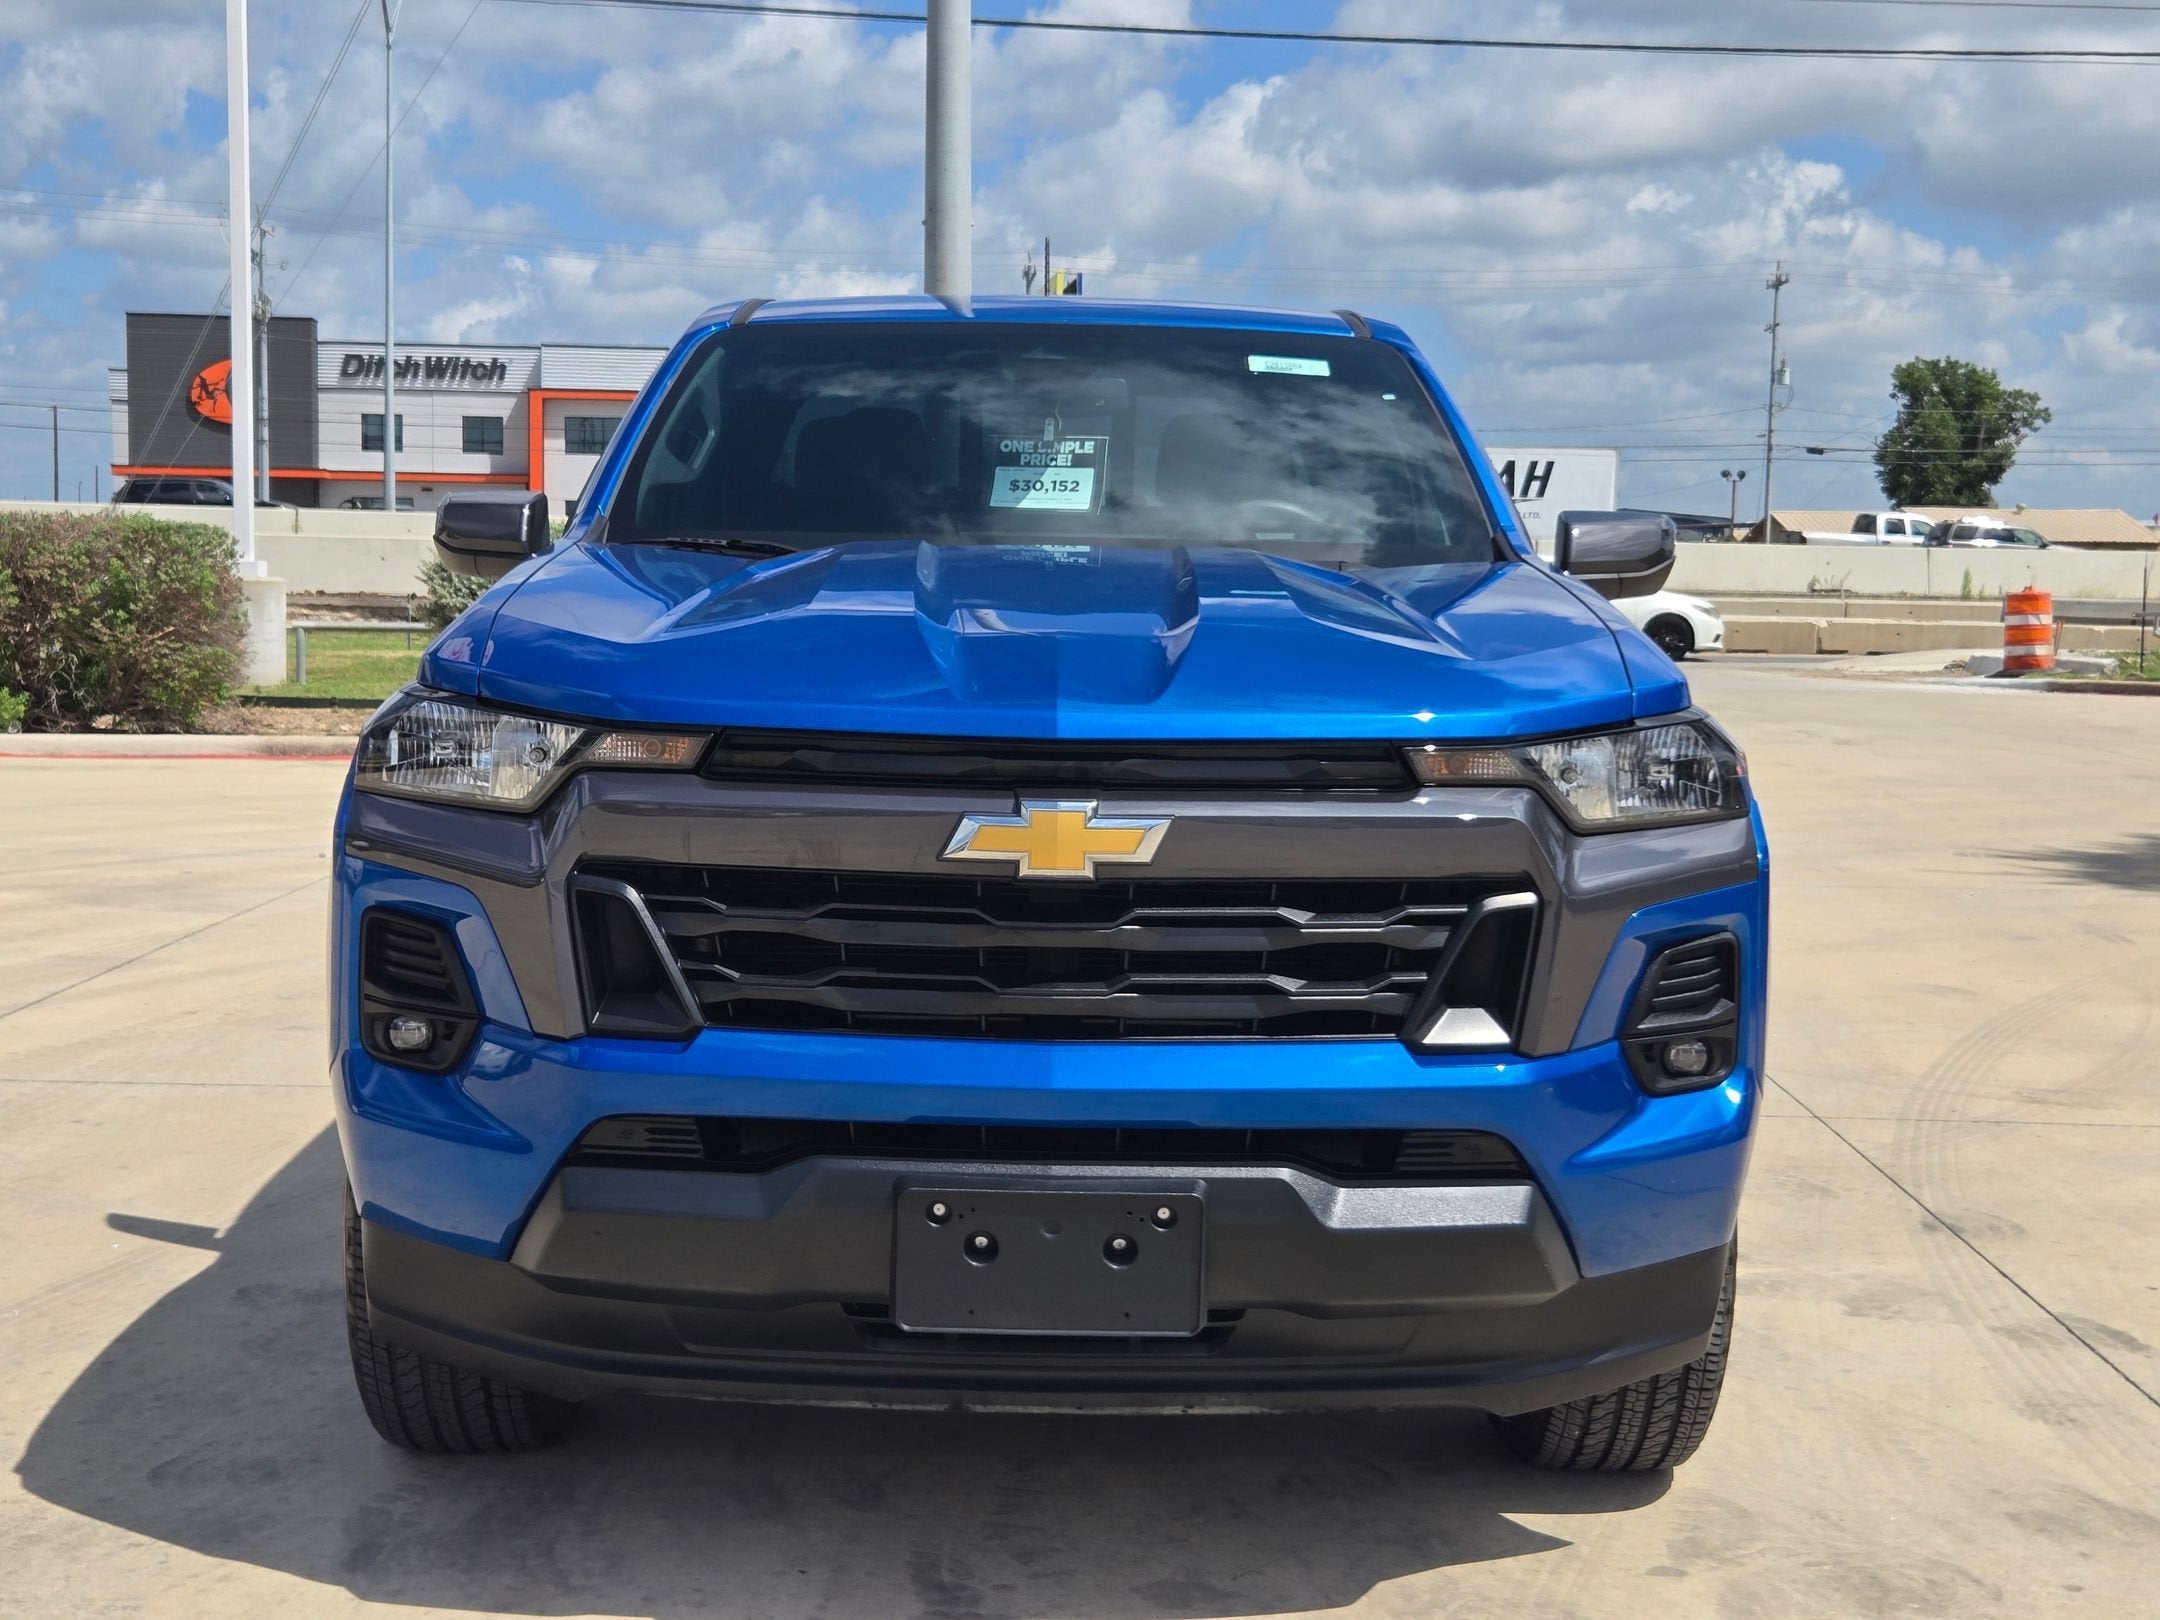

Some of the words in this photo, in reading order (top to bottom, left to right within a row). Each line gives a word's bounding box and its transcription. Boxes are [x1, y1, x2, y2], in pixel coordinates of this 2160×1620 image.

[340, 354, 422, 378] Ditch
[424, 356, 508, 381] Witch
[1000, 440, 1034, 453] ONE
[1037, 441, 1095, 454] SMPLE
[1020, 454, 1072, 466] PRICE!
[1009, 479, 1080, 494] $30,152
